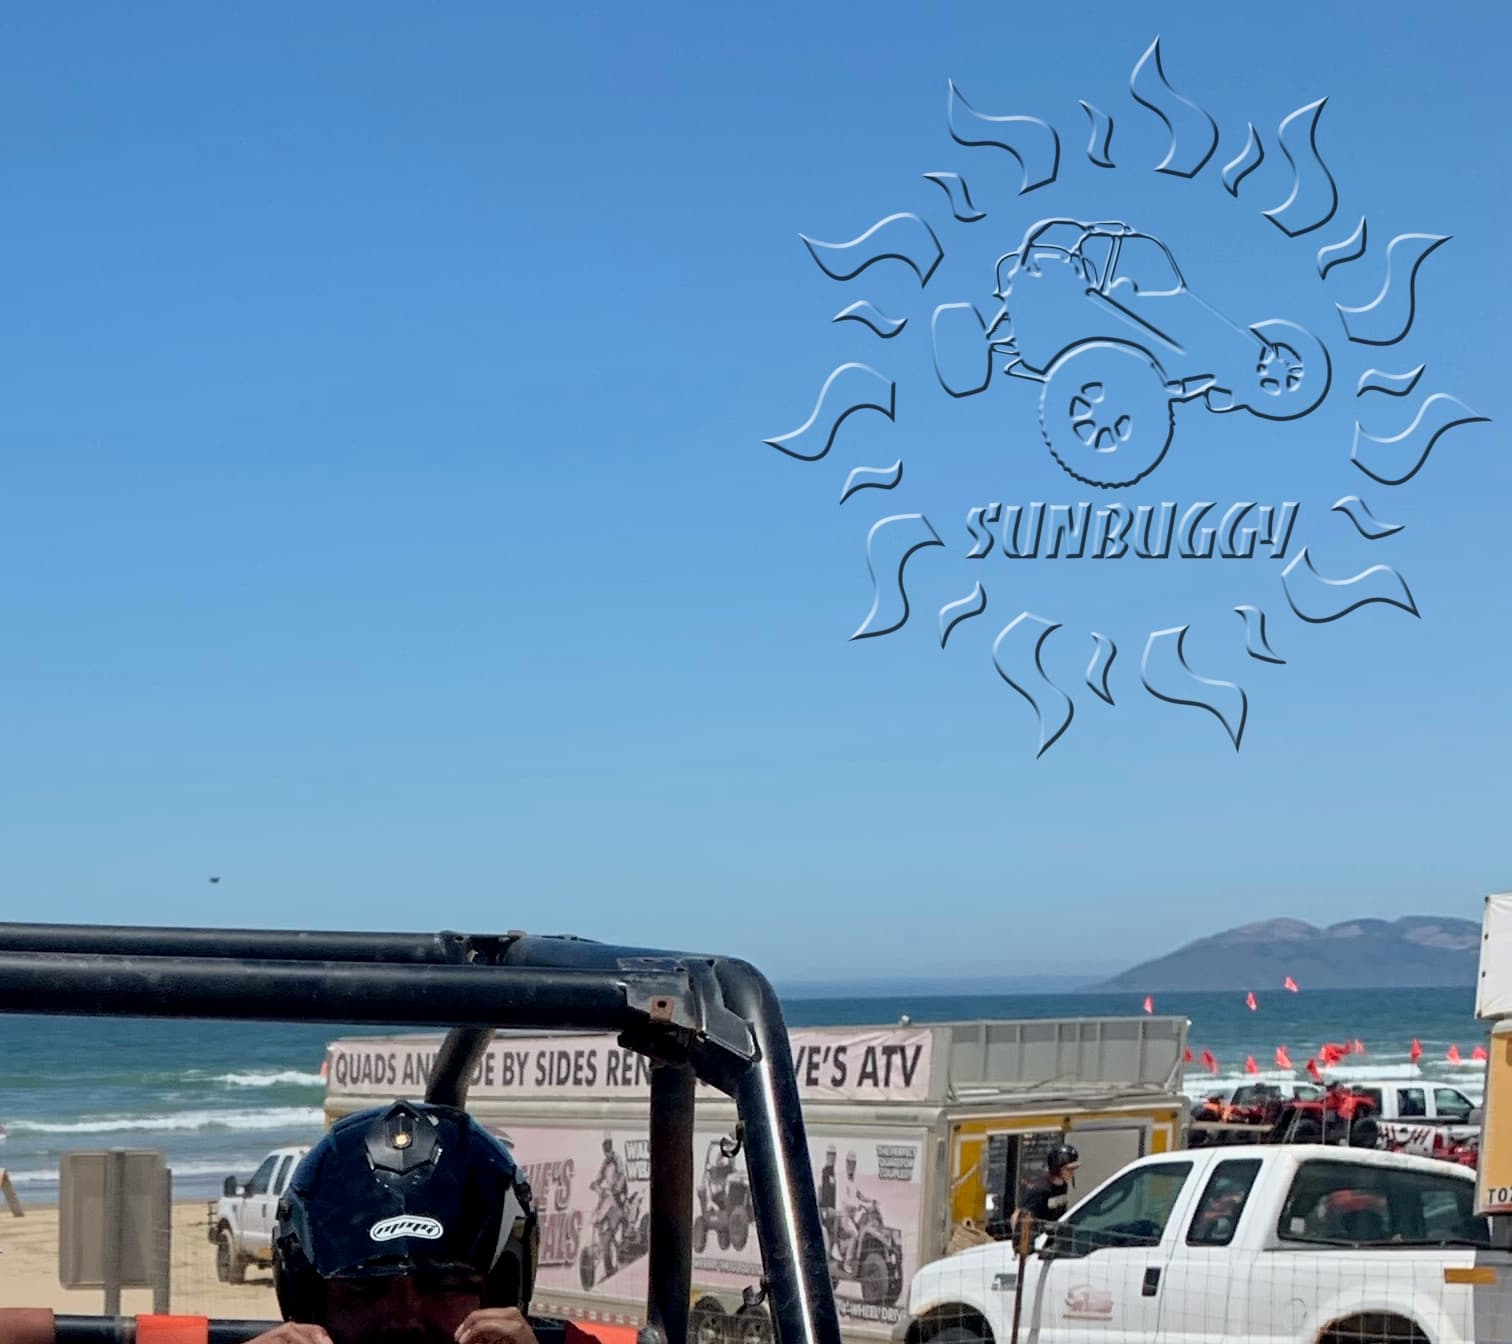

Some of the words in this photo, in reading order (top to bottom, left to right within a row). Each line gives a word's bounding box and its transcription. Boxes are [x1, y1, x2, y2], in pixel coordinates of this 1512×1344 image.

[336, 1052, 397, 1087] QUADS
[402, 1052, 438, 1086] AN
[502, 1051, 530, 1087] BY
[535, 1049, 597, 1087] SIDES
[606, 1050, 653, 1087] REN
[794, 1045, 848, 1087] VE'S
[857, 1044, 924, 1088] ATV
[1488, 1187, 1512, 1204] TO
